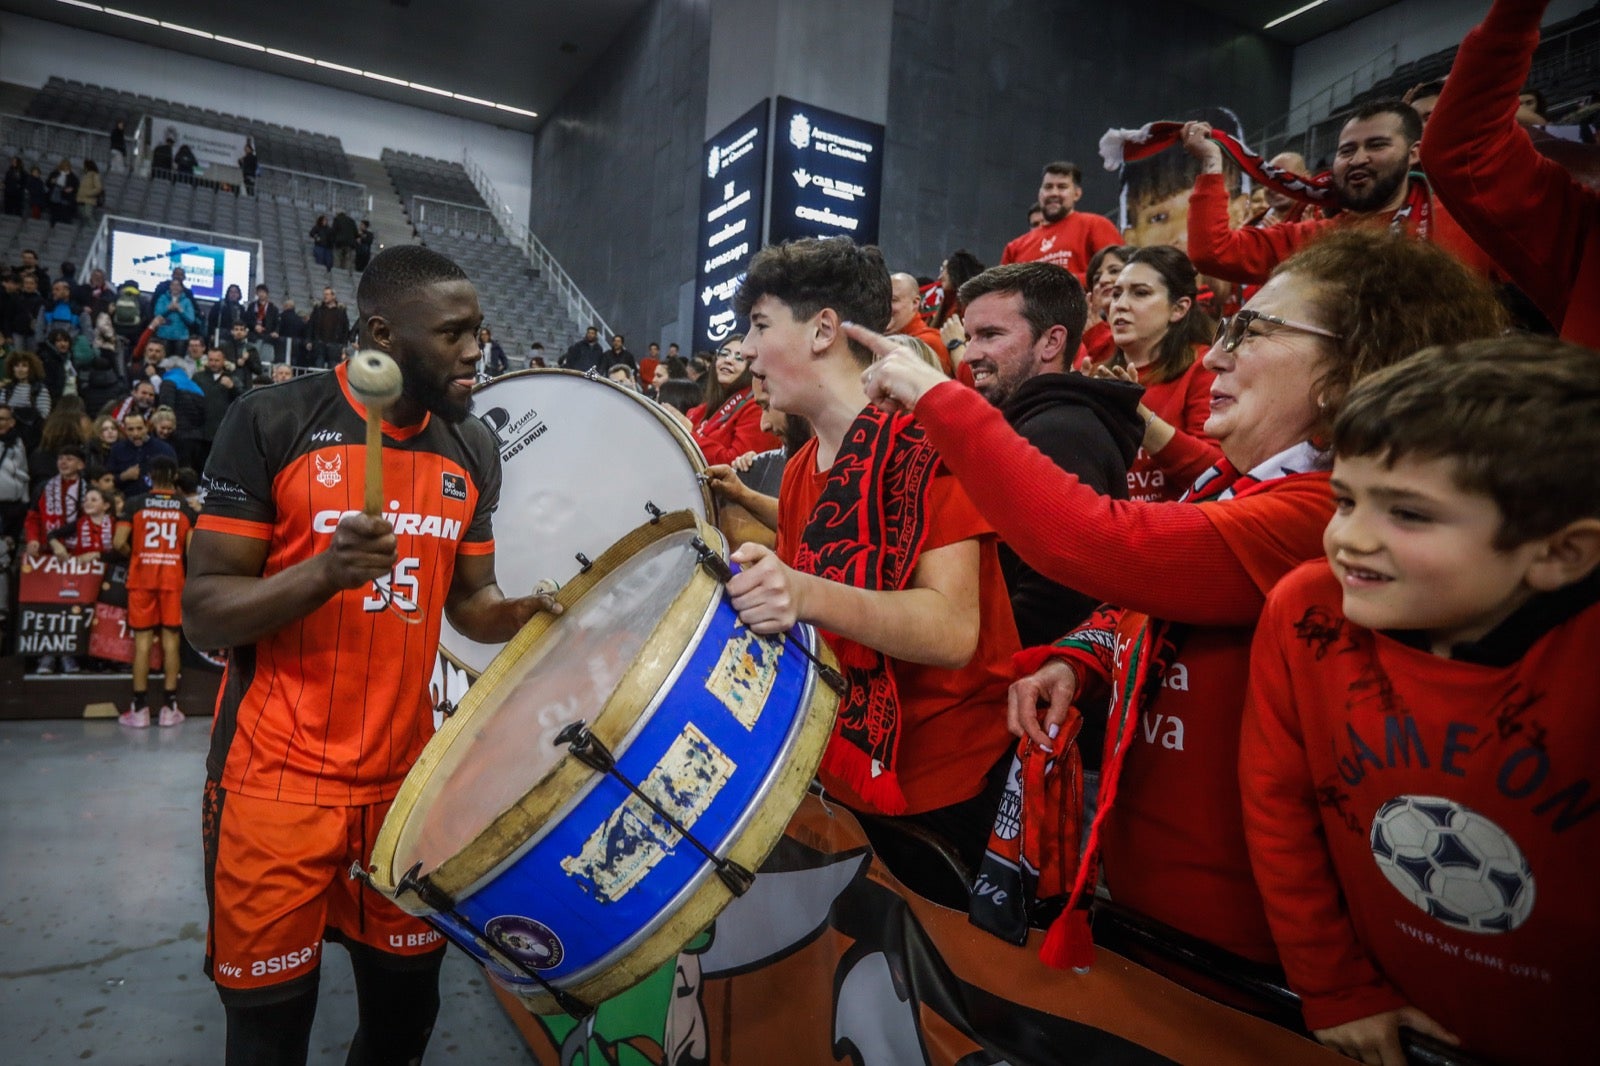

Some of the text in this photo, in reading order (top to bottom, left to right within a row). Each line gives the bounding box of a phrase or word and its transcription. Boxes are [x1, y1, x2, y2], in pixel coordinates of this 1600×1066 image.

[502, 425, 548, 462] BASS DRUM
[142, 510, 180, 520] PULEVA
[313, 500, 461, 540] CIRAN
[144, 521, 177, 549] 24
[19, 632, 77, 652] NIANG
[1337, 715, 1478, 786] GAME
[1496, 747, 1600, 834] ON
[251, 945, 314, 977] asisa
[1464, 948, 1505, 971] GAME
